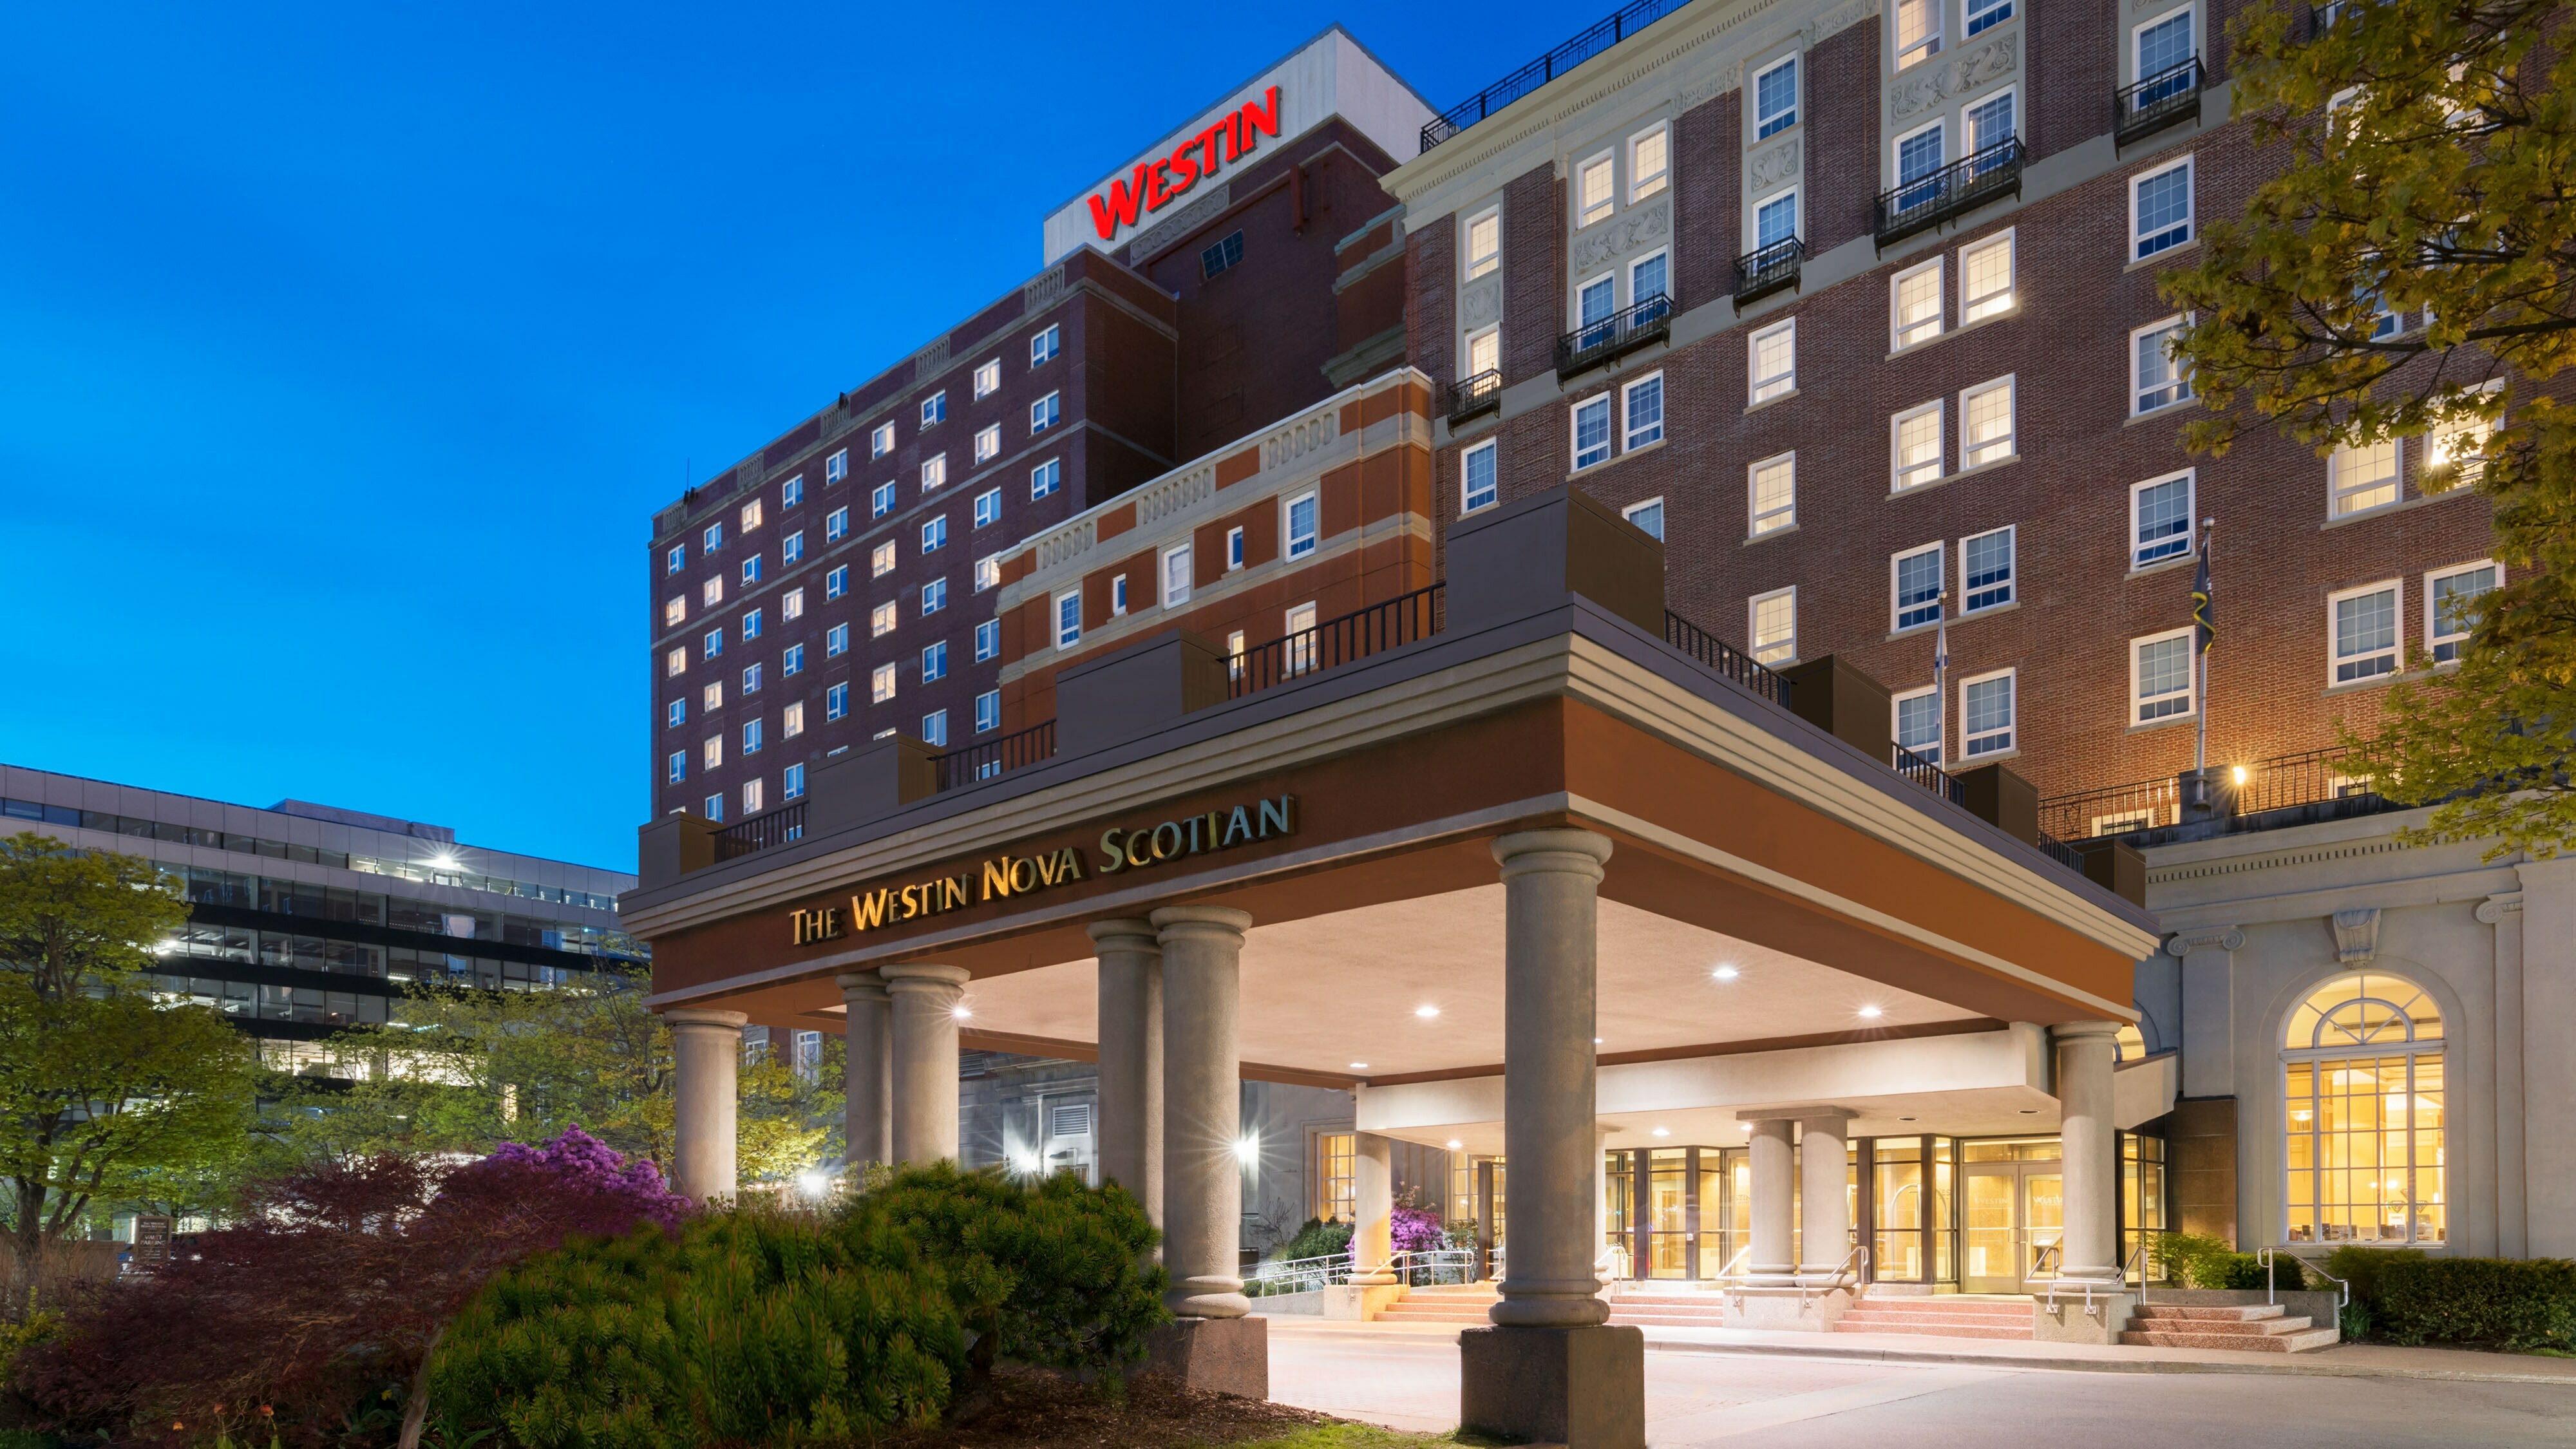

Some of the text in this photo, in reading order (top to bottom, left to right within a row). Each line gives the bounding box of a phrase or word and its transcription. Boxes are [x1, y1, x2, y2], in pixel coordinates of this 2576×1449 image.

[1086, 85, 1280, 240] WESTIN
[789, 793, 1291, 945] THE WESTIN NOVA SCOTIAN
